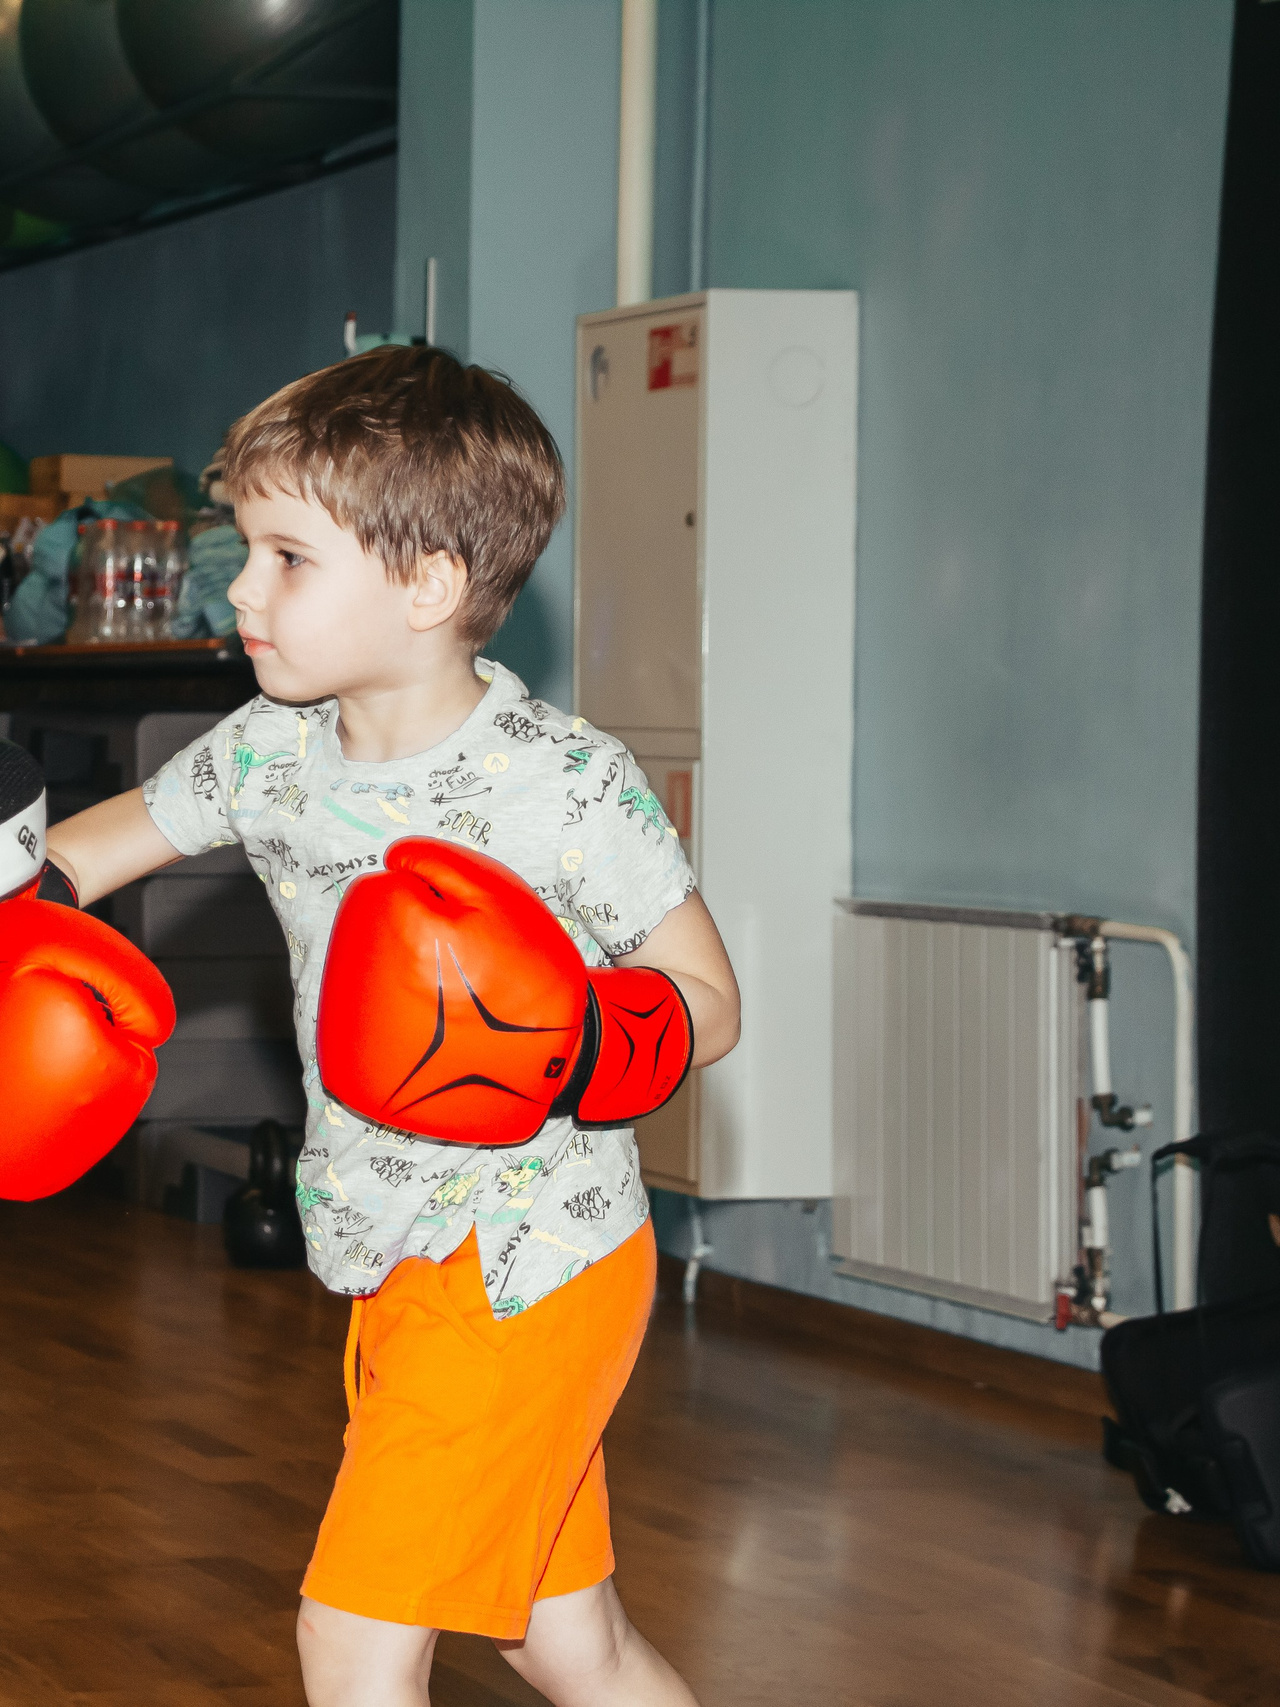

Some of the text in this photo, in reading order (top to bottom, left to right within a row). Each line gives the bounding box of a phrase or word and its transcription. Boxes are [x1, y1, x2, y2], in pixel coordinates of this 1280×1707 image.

[428, 766, 463, 778] choose
[445, 771, 477, 790] Fun
[593, 760, 619, 803] LAZY
[17, 824, 38, 860] GEL
[437, 809, 492, 847] SUPER
[577, 903, 619, 924] UPER
[303, 1145, 329, 1158] DAYS
[344, 1239, 384, 1269] SUPER
[498, 1222, 531, 1265] DAYS
